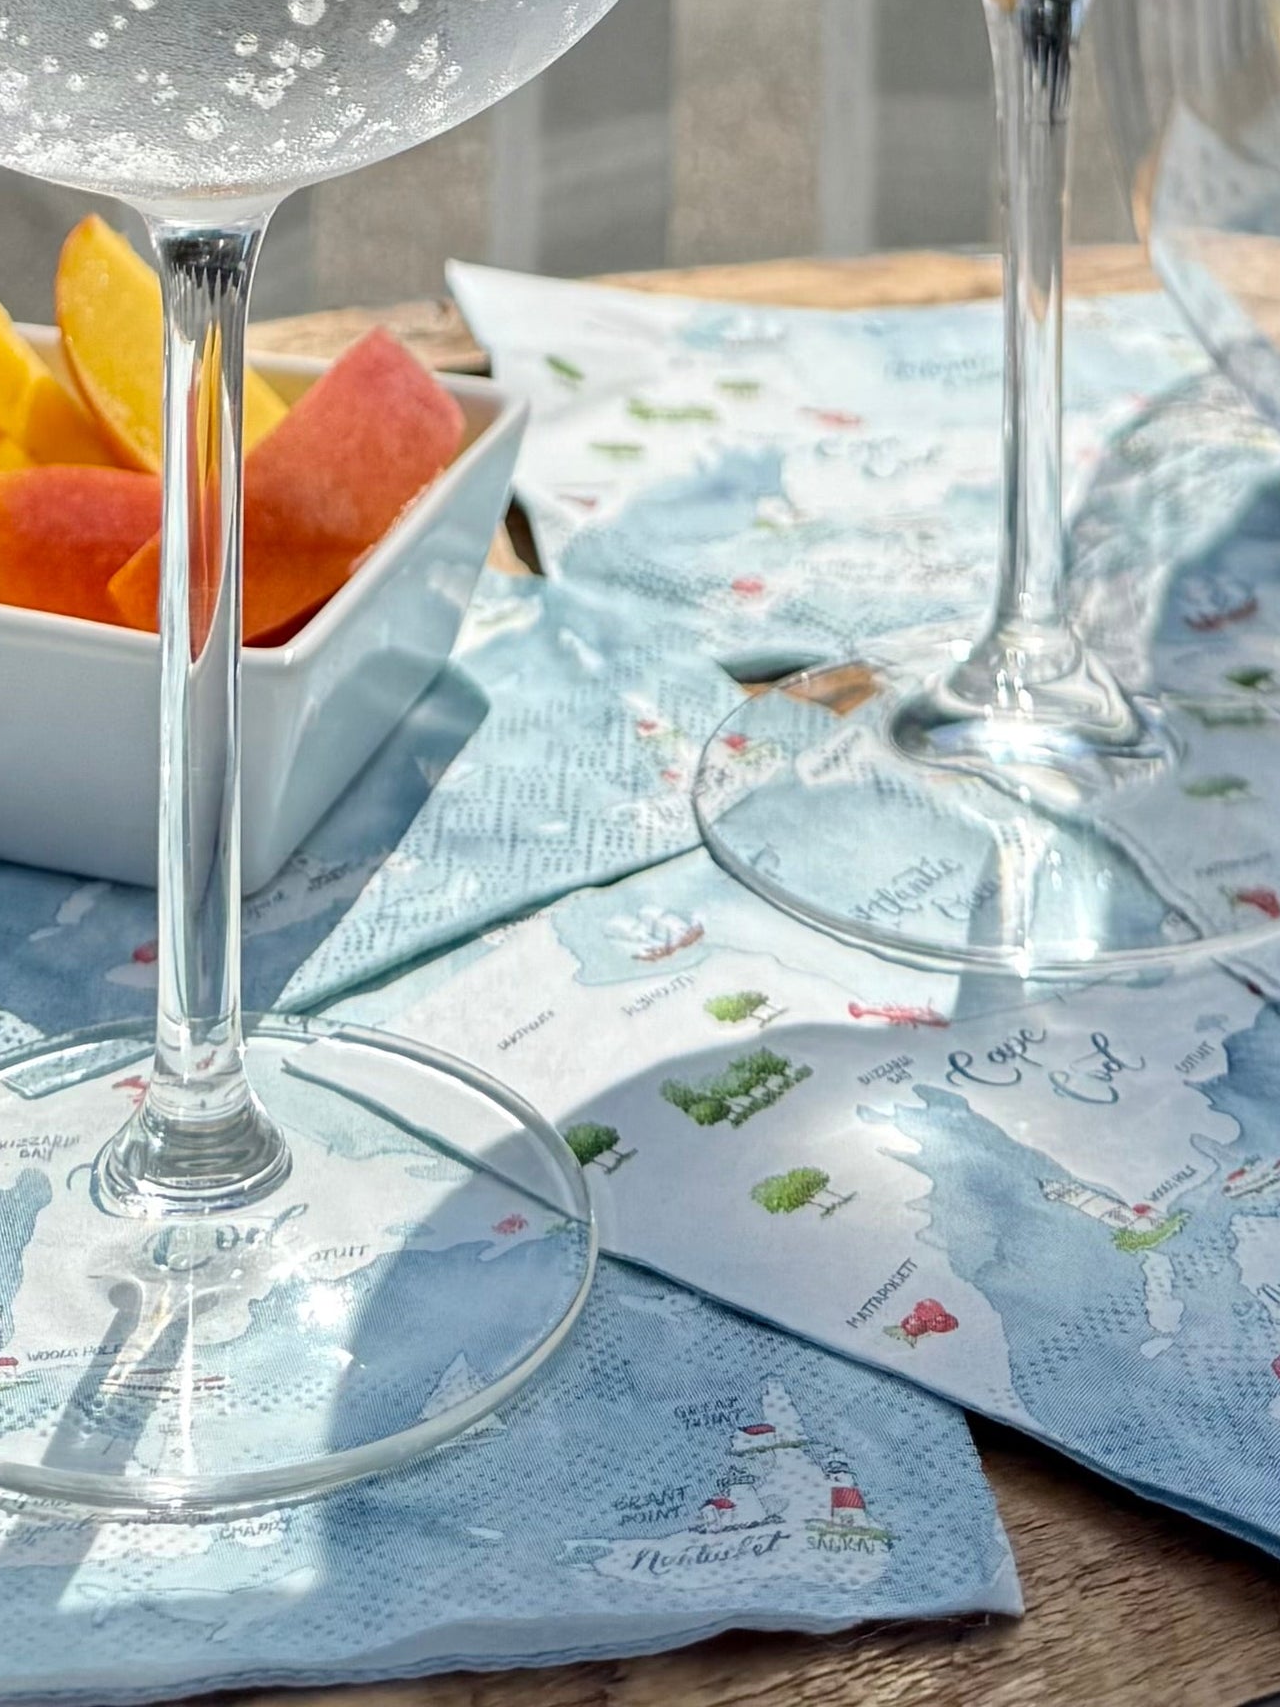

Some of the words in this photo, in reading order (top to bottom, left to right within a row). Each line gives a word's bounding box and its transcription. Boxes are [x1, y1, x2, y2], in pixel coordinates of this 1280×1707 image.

[946, 1027, 1048, 1088] Cape
[1049, 1031, 1147, 1105] Cod
[844, 1256, 919, 1329] MATTAPOISETT
